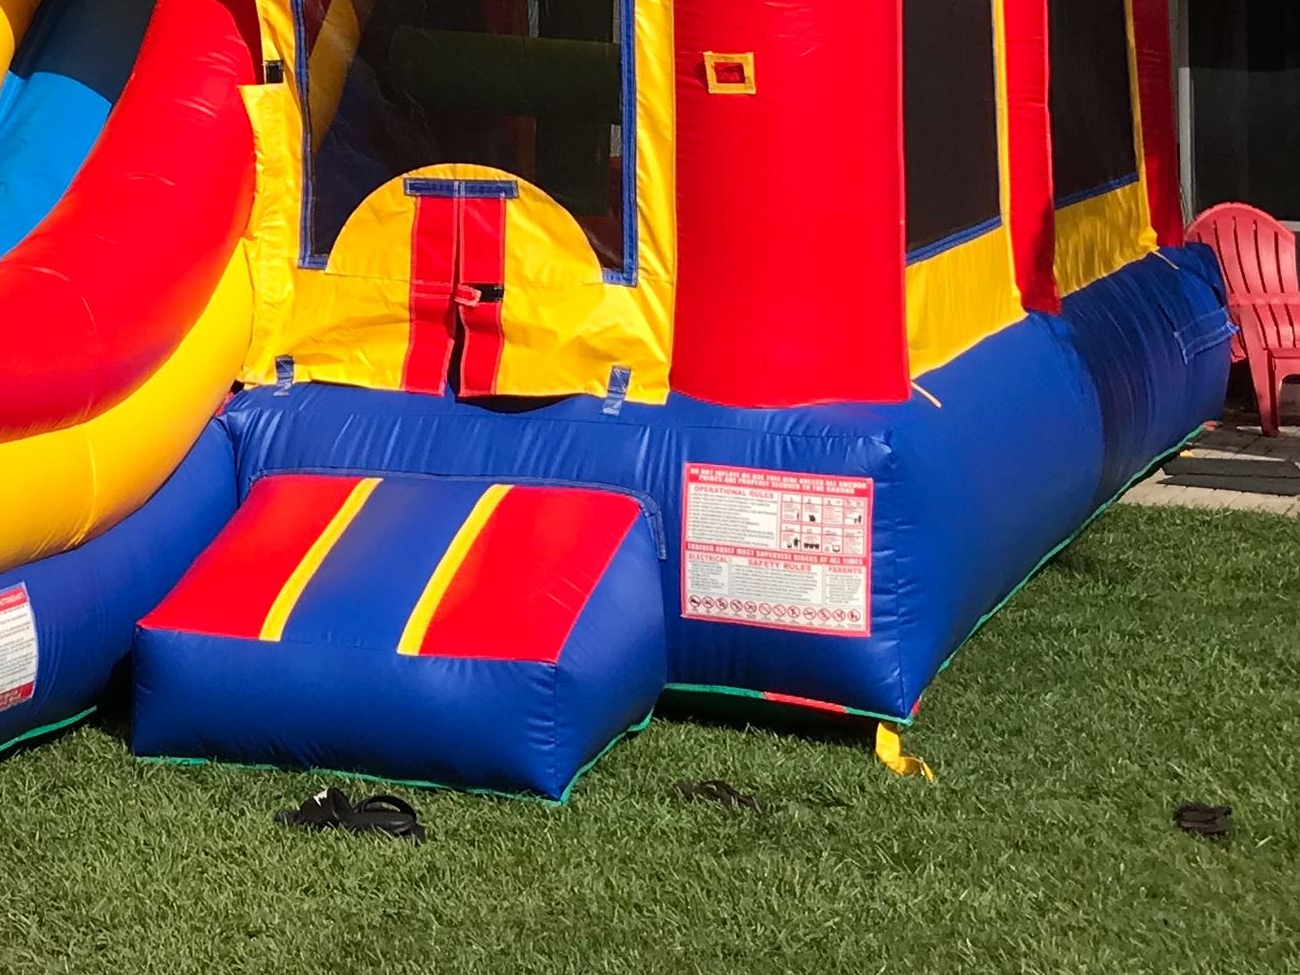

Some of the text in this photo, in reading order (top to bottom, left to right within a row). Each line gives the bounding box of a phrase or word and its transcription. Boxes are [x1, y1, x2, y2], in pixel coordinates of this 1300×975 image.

[693, 485, 774, 499] OPERATIONAL RULES
[688, 553, 728, 563] ELECTRICAL
[748, 558, 811, 572] SAFETY RULES
[827, 566, 862, 574] PARENTS
